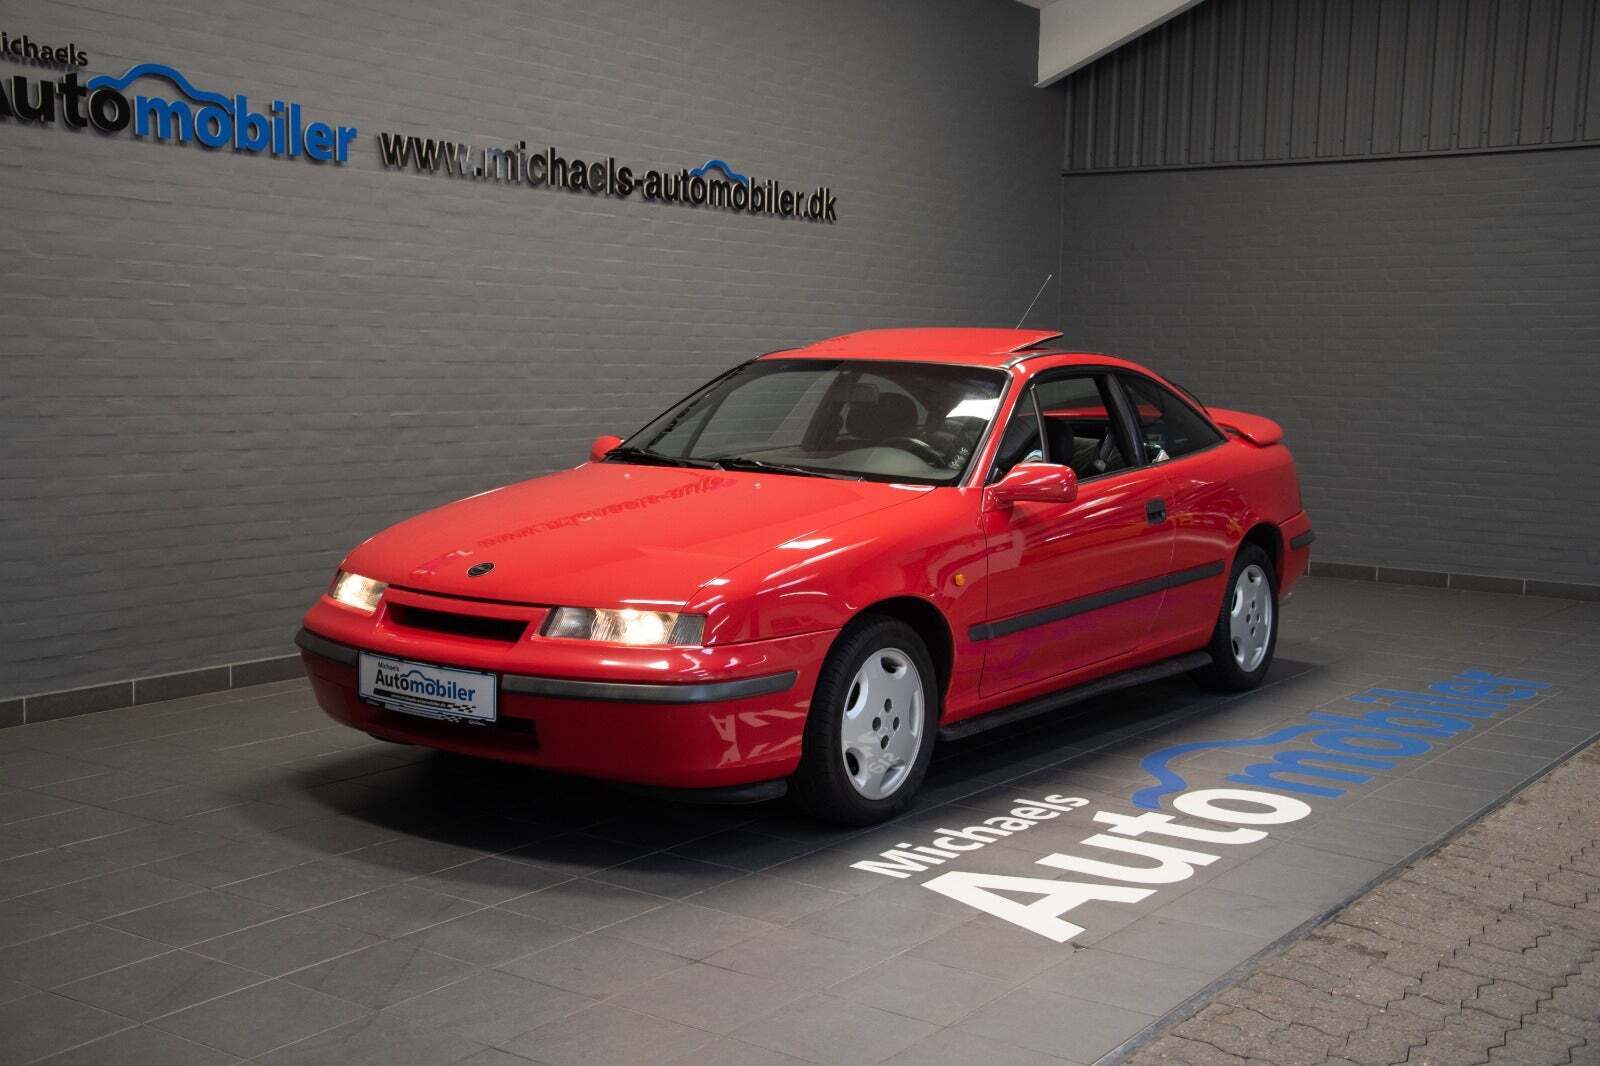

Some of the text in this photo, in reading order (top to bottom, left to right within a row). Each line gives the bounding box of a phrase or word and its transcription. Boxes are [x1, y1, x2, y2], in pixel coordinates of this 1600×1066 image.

[0, 31, 88, 67] ichaels
[377, 131, 837, 222] www.michaels-automobiler.dk
[375, 669, 475, 702] Automobiler
[850, 791, 1090, 879] Michaels
[920, 668, 1551, 943] Automobiler
